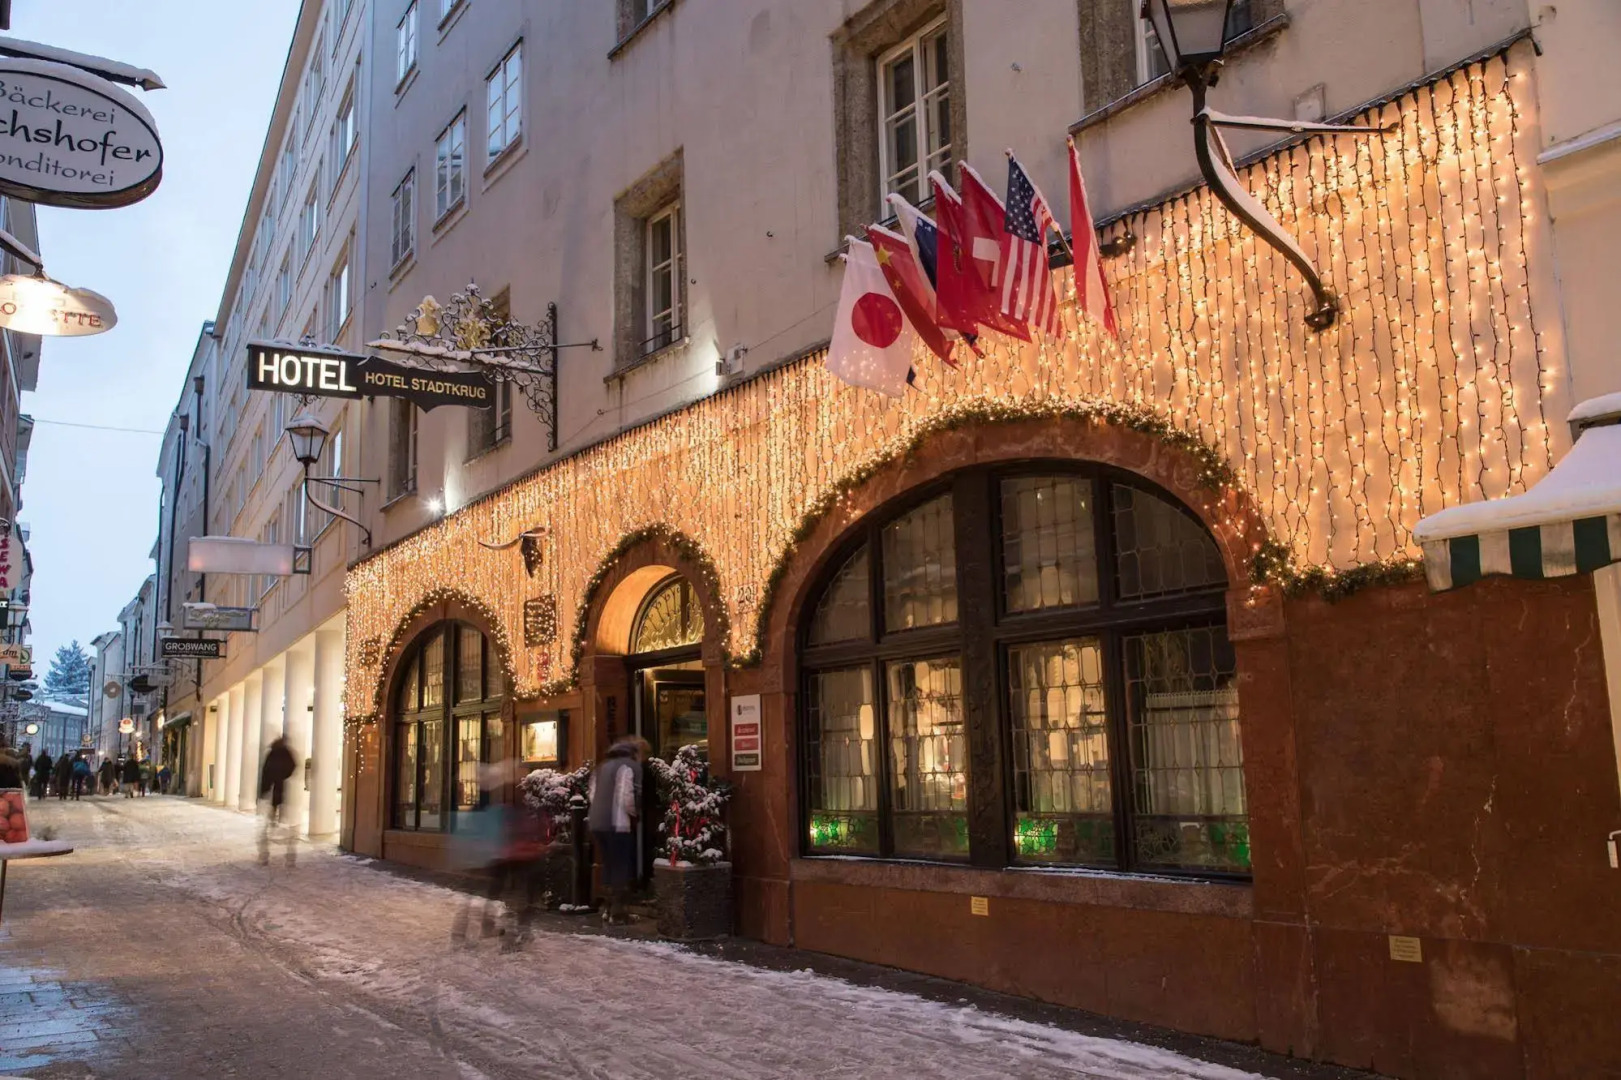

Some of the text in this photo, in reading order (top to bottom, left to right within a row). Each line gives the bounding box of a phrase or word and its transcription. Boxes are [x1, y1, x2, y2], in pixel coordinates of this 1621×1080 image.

[258, 352, 357, 392] HOTEL
[365, 371, 487, 399] HOTEL STADTKRUG
